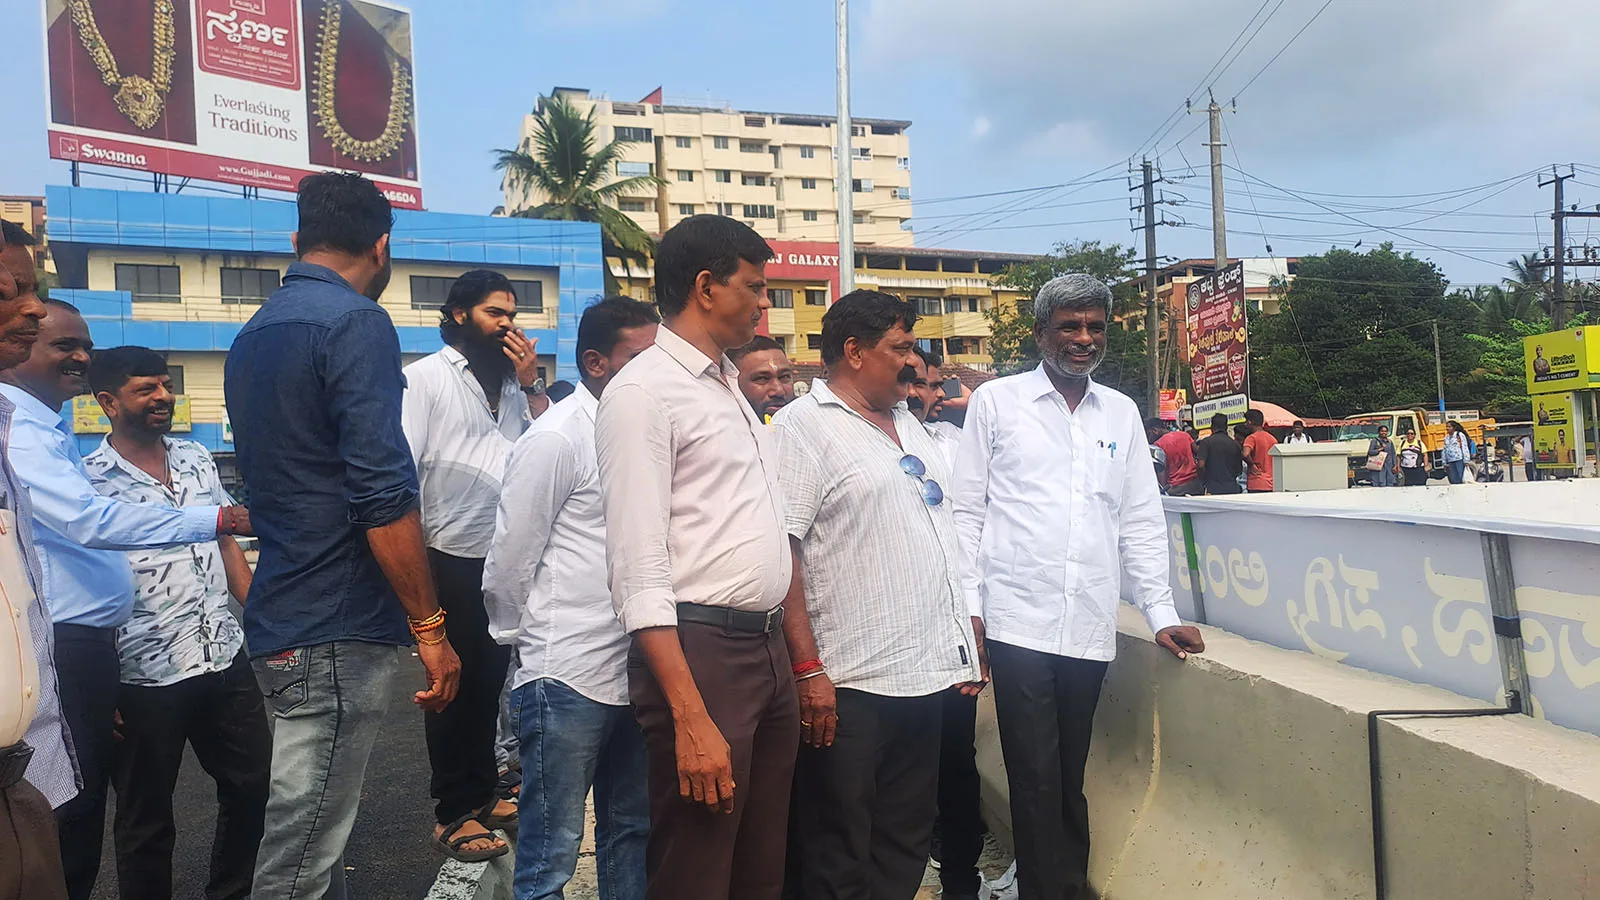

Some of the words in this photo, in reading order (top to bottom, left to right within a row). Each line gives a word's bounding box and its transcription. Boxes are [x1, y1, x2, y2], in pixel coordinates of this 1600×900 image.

[213, 93, 291, 123] Everlasting
[207, 111, 298, 141] Traditions
[81, 142, 147, 166] Swarna
[788, 253, 839, 267] GALAXY
